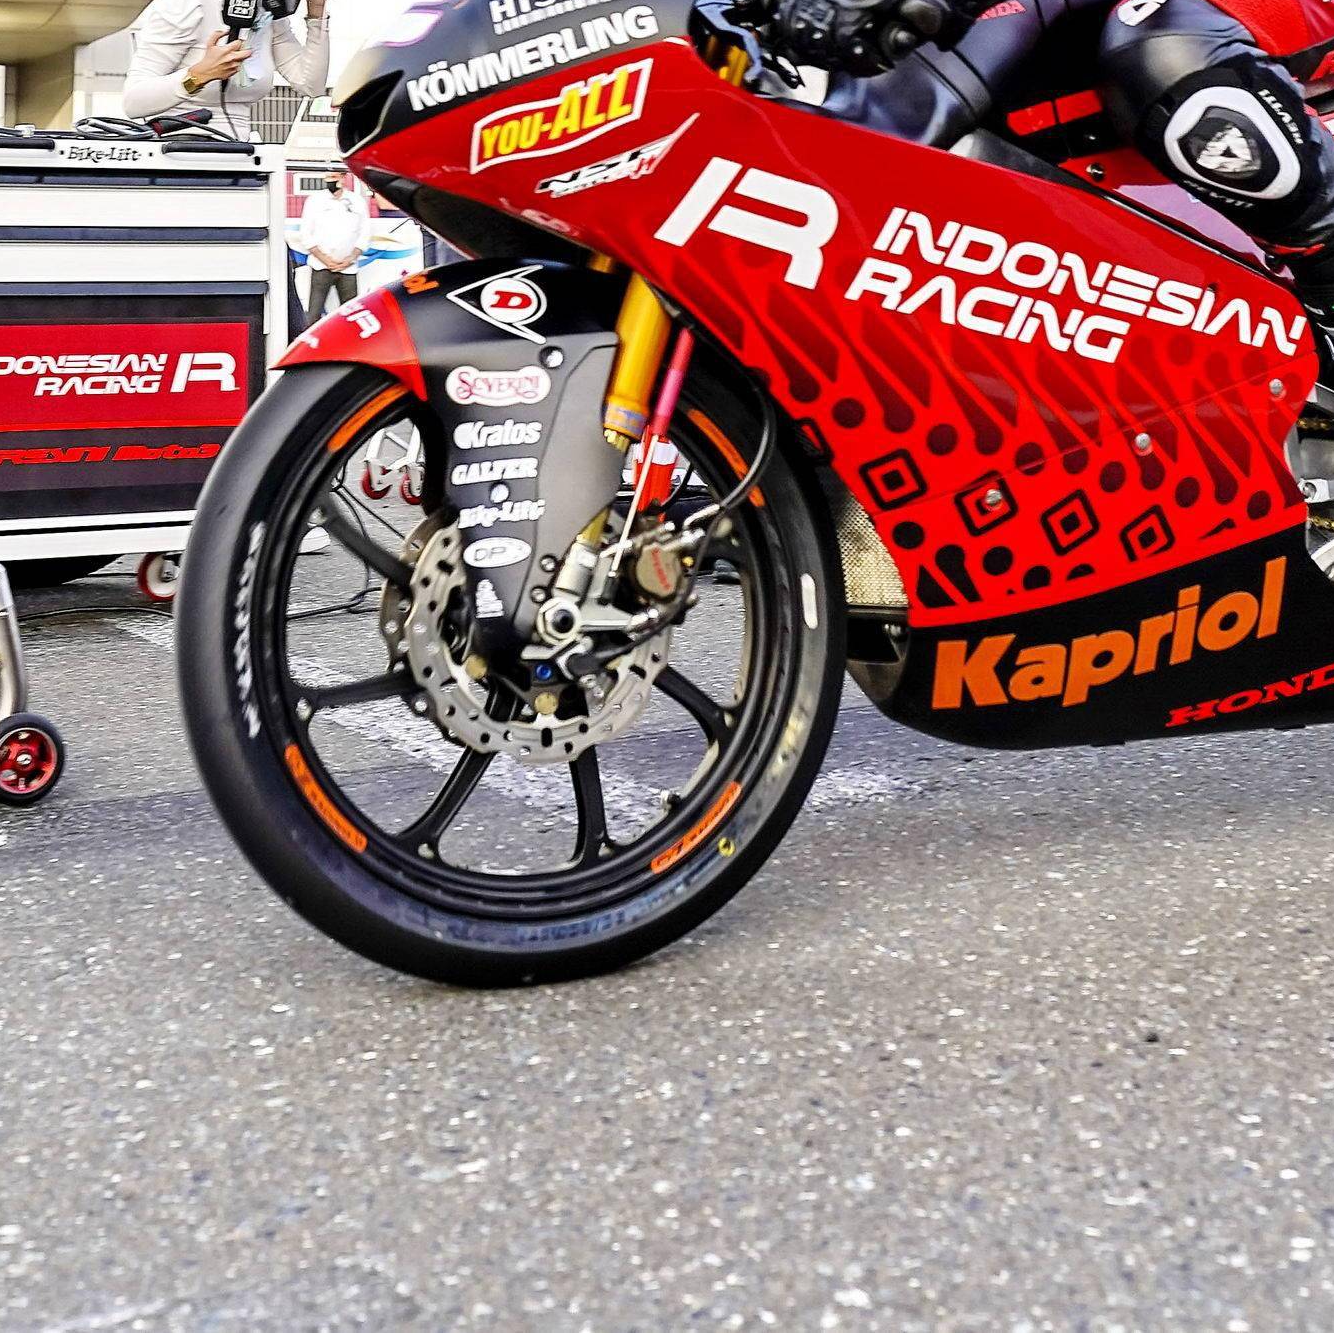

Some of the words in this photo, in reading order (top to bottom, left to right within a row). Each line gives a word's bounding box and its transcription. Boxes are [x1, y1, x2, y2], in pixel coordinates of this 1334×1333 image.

[405, 5, 660, 112] KÖMMERLING
[67, 146, 141, 163] Bike-Lift
[480, 69, 634, 160] YOU-ALL
[843, 256, 1132, 365] RACING
[872, 206, 1307, 357] INDONESIAN
[34, 375, 164, 398] RACING
[931, 555, 1288, 711] Kapriol
